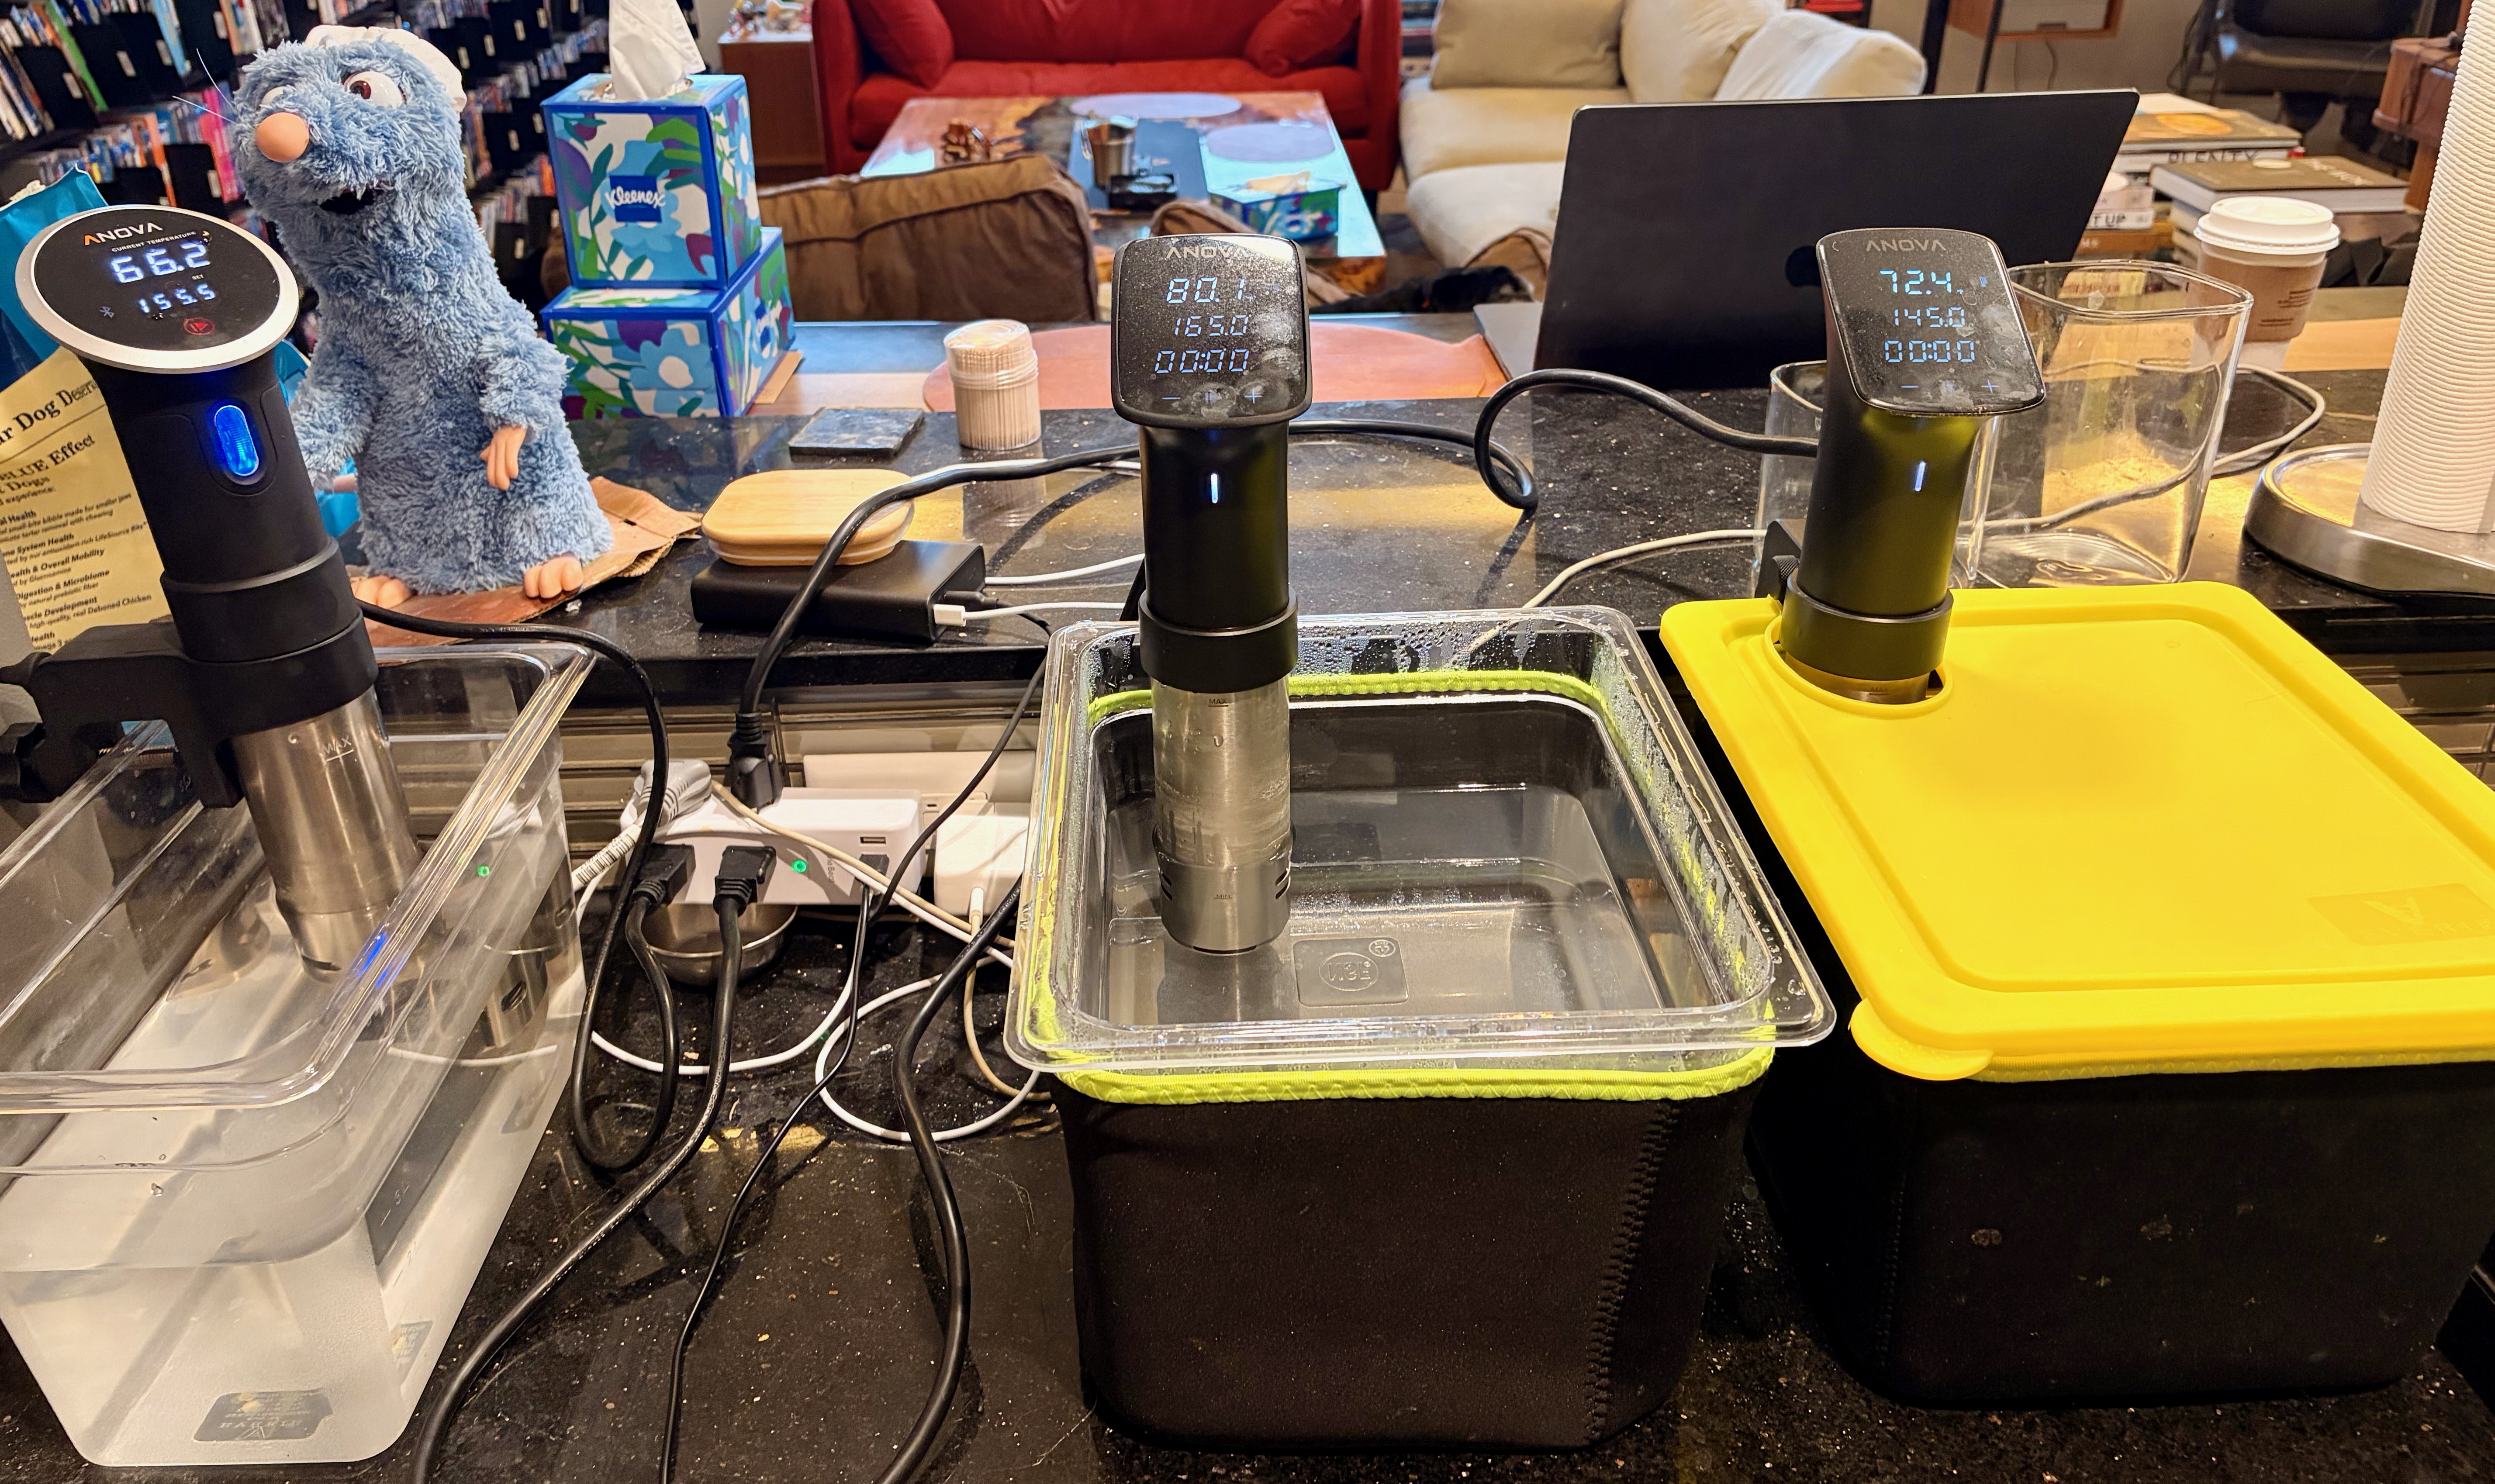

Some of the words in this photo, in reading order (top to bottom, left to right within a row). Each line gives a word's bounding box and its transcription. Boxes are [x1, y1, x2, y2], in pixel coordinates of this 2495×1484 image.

[605, 186, 666, 209] Kleenex
[84, 222, 163, 245] ANOVA
[111, 242, 145, 252] CURRENT
[146, 231, 197, 245] TEMPERATURE
[1166, 246, 1248, 259] ANOVA
[1866, 239, 1946, 251] ANOVA
[110, 241, 211, 283] 66.2
[1166, 277, 1245, 304] 80.1
[1879, 269, 1952, 295] 72.4
[1174, 314, 1248, 337] 165.0
[1894, 307, 1966, 327] 145.0
[1154, 349, 1249, 373] 00:00
[1884, 340, 1975, 362] 00:00
[13, 400, 61, 431] Dog
[48, 434, 96, 466] Effect
[6, 477, 50, 491] Dogs
[8, 509, 36, 523] Health
[64, 507, 83, 517] made
[85, 504, 94, 512] for
[70, 516, 84, 525] with
[17, 542, 46, 554] System
[48, 532, 74, 545] Health
[41, 556, 70, 571] Overall
[71, 548, 105, 563] Mobility
[63, 569, 110, 588] Microbiome
[28, 594, 52, 606] natural
[44, 596, 97, 617] Development
[73, 608, 87, 618] real
[87, 600, 121, 614] Deboned
[121, 594, 152, 606] Chicken
